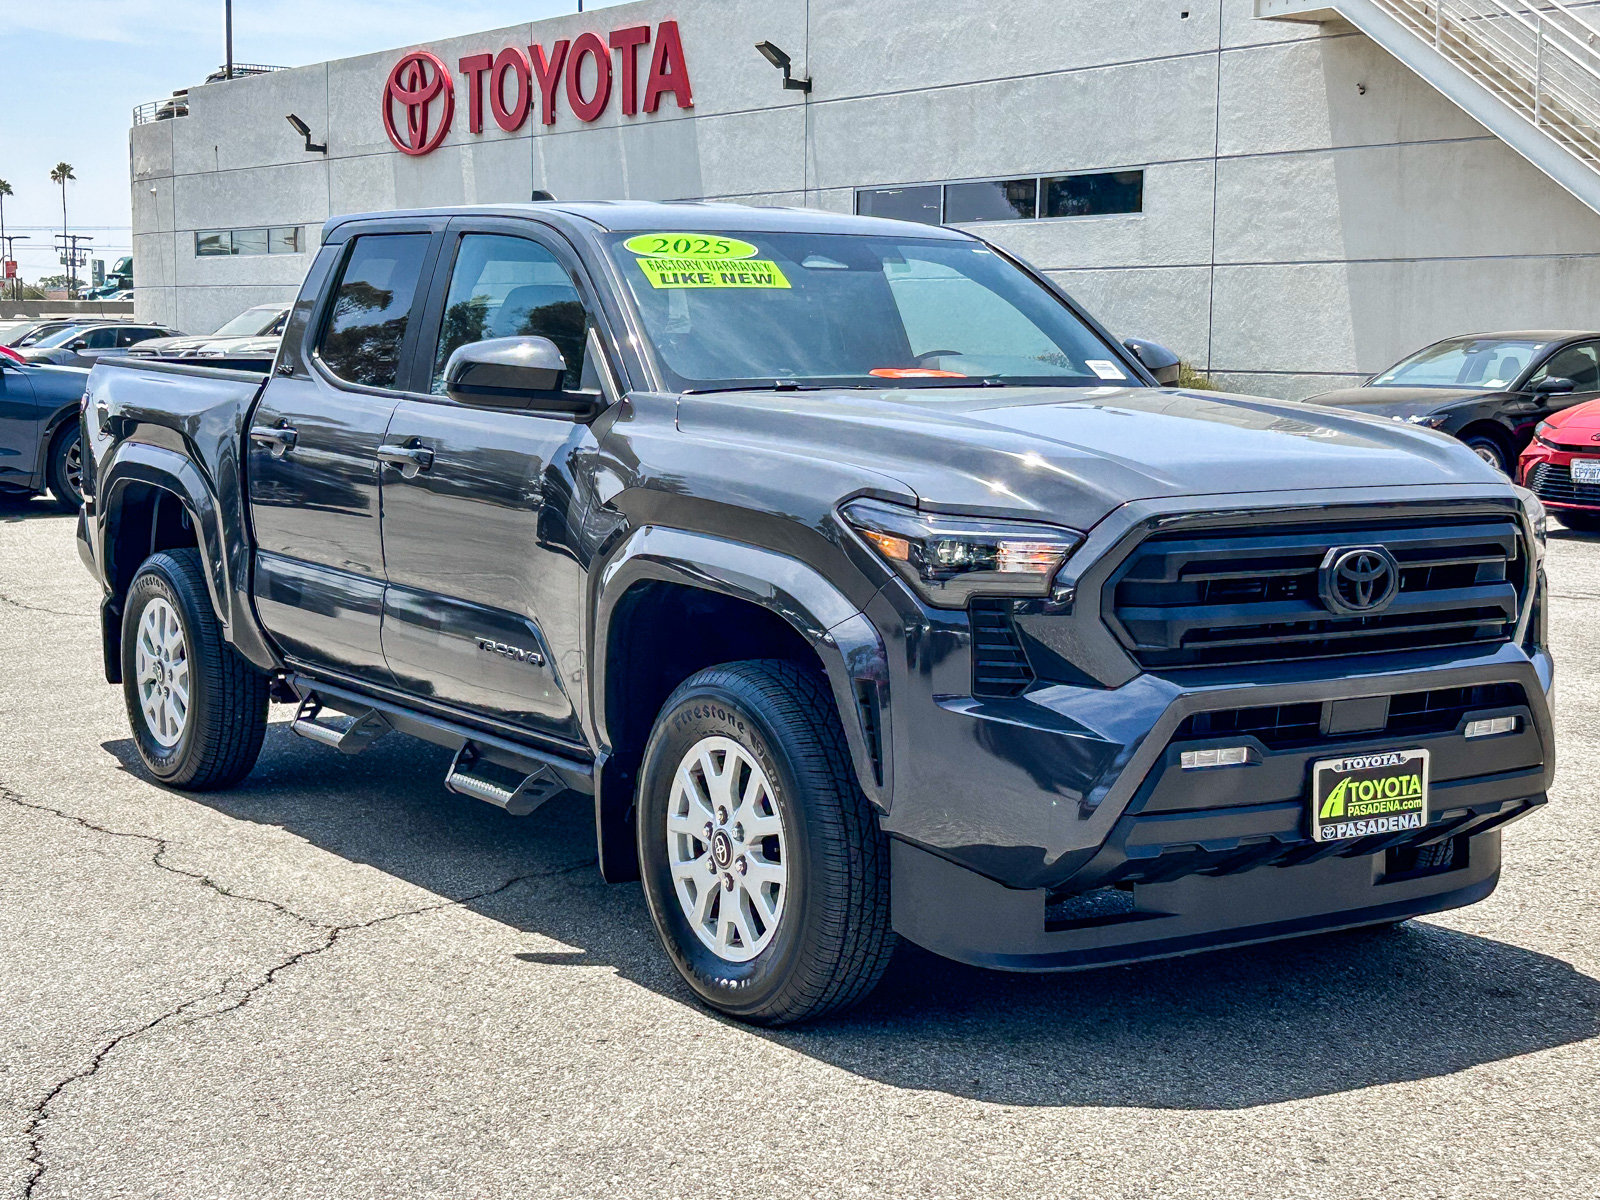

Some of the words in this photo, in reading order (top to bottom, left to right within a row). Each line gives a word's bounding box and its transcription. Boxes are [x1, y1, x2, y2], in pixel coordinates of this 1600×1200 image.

[459, 20, 694, 133] TOYOTA
[652, 238, 731, 255] 2025
[646, 259, 701, 273] FACTORY
[702, 260, 770, 273] WARRANTY
[659, 272, 713, 285] LIKE
[721, 272, 774, 286] NEW
[672, 704, 746, 735] Firestone
[1345, 754, 1399, 770] TOYOTA
[1348, 774, 1422, 803] TOYOTA
[1347, 799, 1422, 818] PASADENA.com
[1337, 813, 1421, 839] PASADENA
